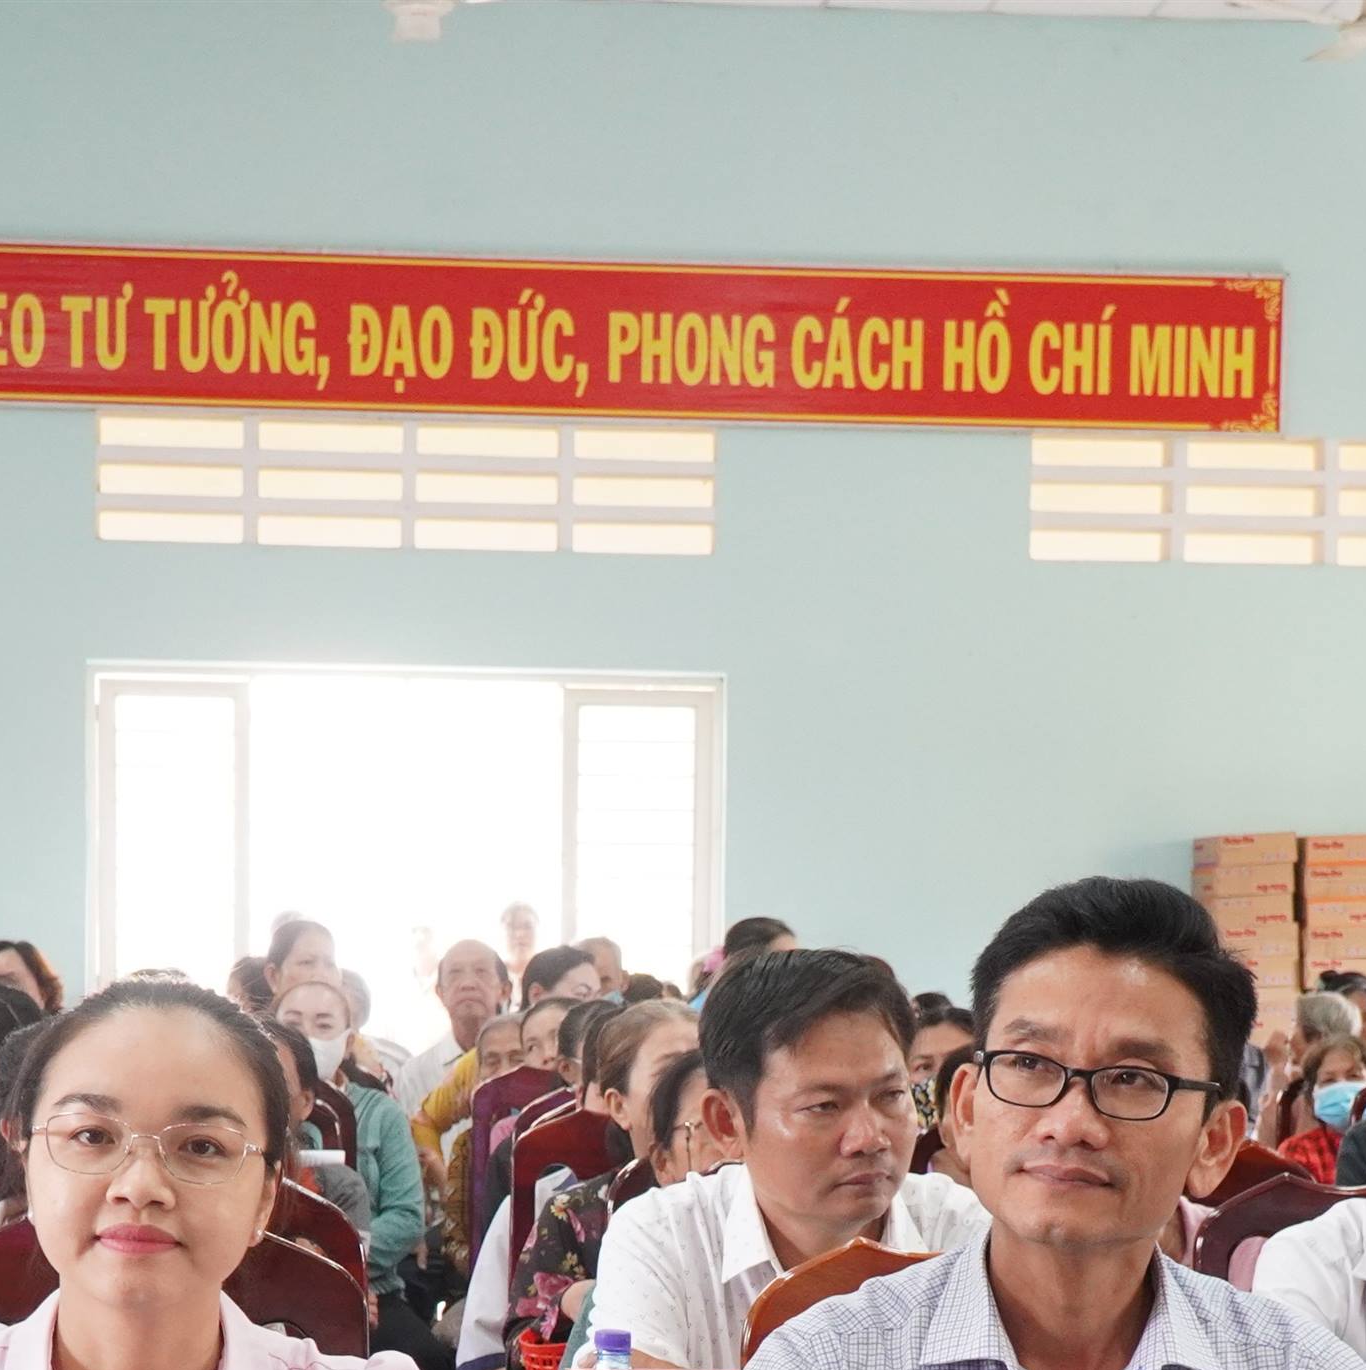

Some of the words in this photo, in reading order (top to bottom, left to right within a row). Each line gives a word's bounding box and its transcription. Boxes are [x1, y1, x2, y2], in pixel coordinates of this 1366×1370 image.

[60, 283, 134, 371] TƯ
[144, 270, 330, 390] TƯỞNG,
[348, 303, 454, 394] ĐẠO
[470, 288, 590, 398] ĐỨC,
[607, 310, 776, 389] PHONG
[791, 295, 924, 392] CÁCH
[942, 288, 1012, 394] HỒ
[1029, 304, 1117, 396] CHÍ
[1130, 325, 1255, 399] MINH
